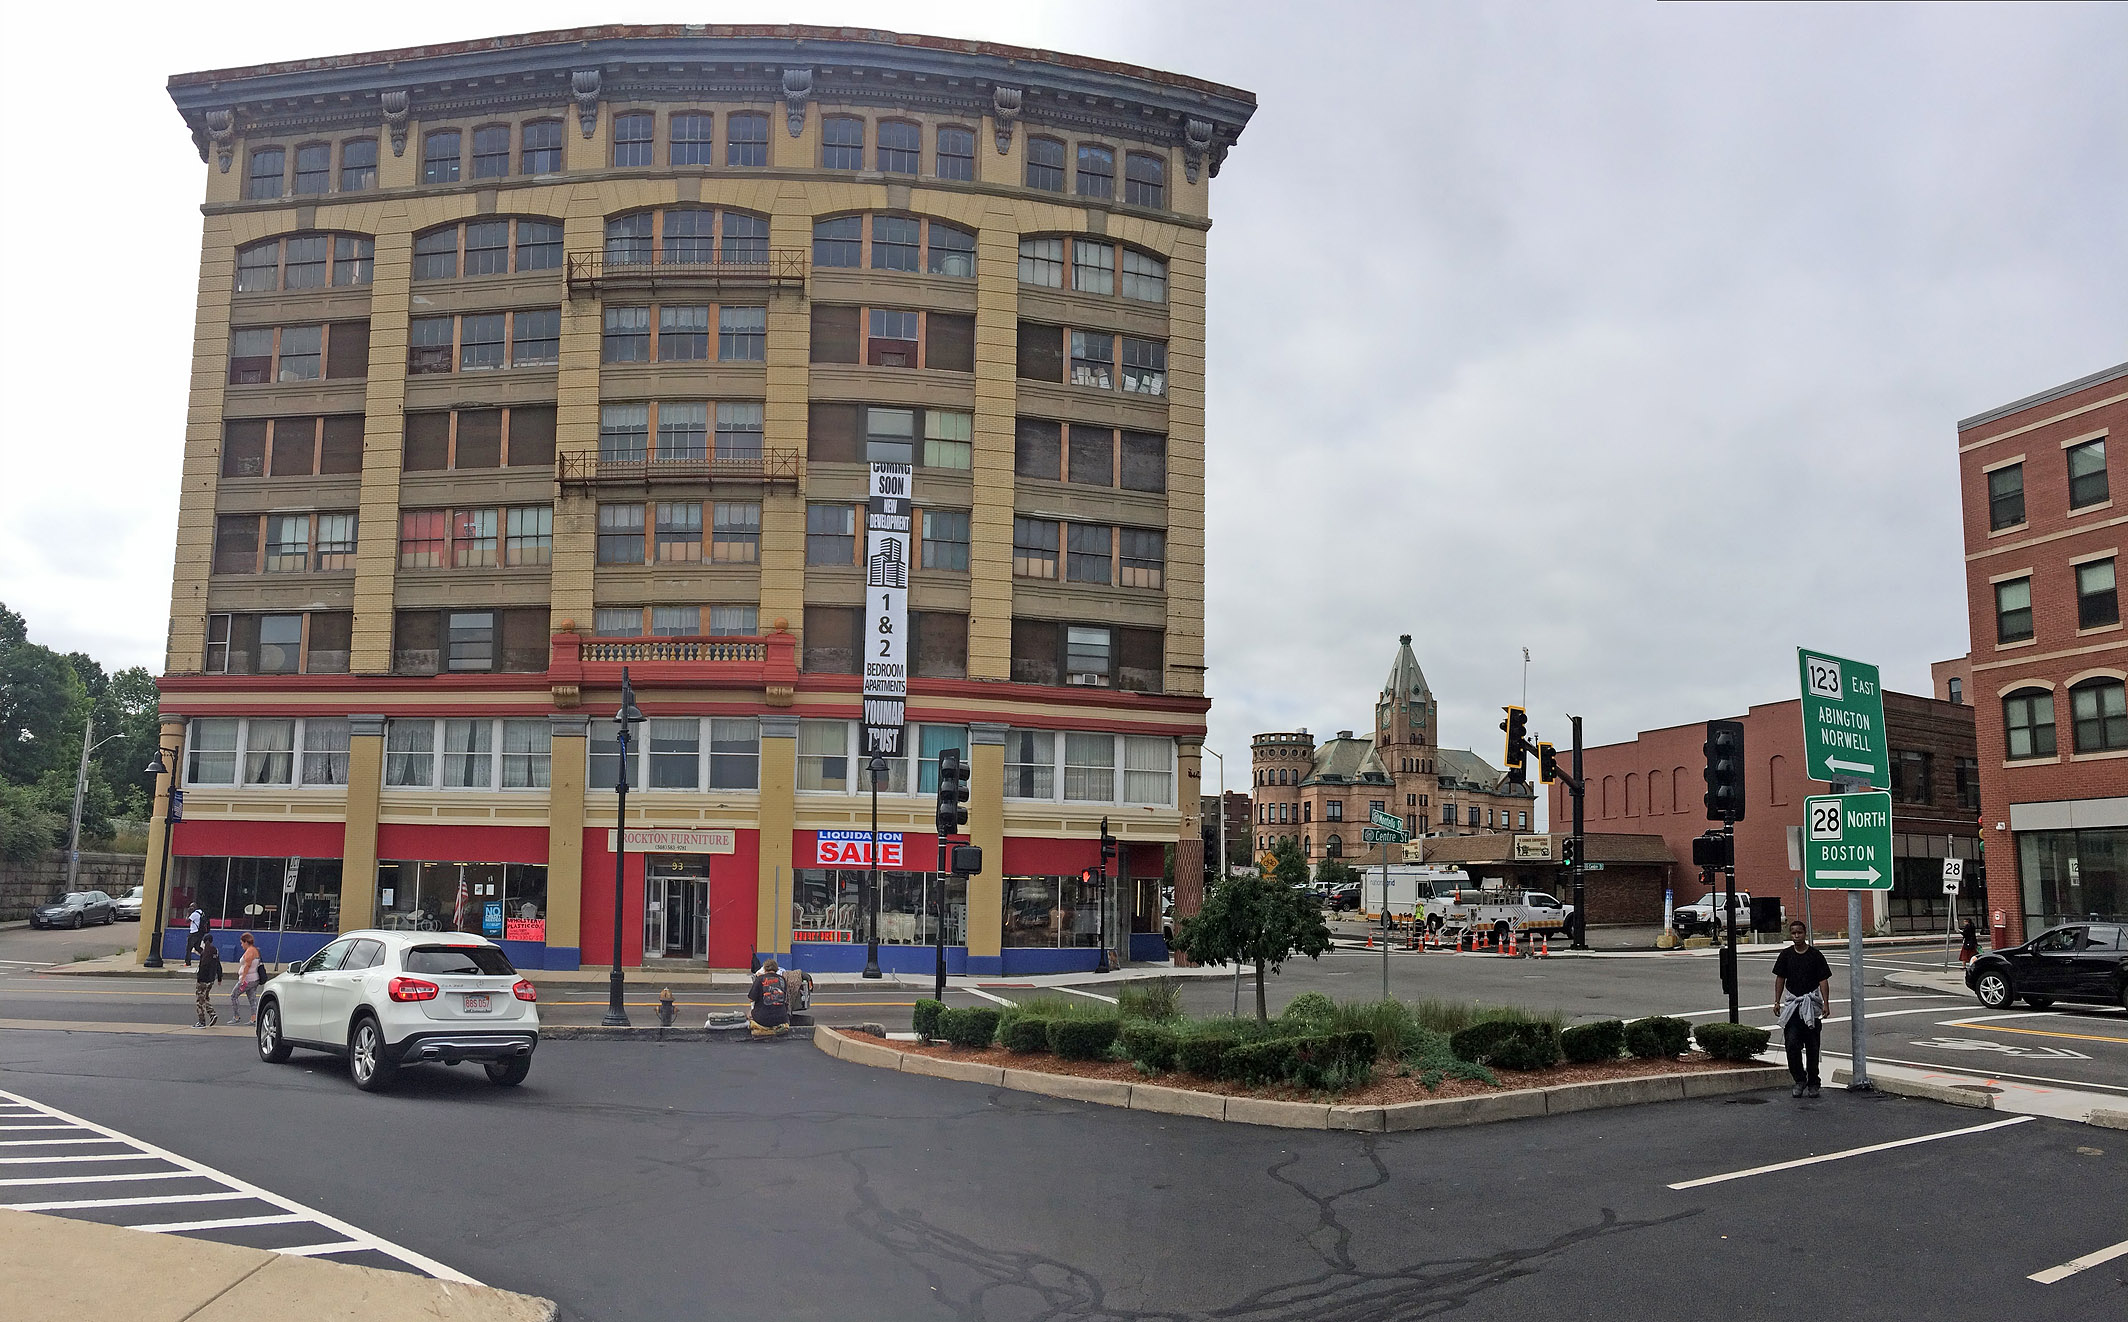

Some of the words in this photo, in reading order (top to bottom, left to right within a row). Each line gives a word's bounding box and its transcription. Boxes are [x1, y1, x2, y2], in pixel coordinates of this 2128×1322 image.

[879, 475, 904, 495] SOON
[883, 499, 898, 514] NEW
[870, 513, 910, 531] DEVELOPMENT
[882, 593, 890, 611] 1
[878, 616, 893, 635] &
[879, 640, 891, 657] 2
[867, 663, 904, 678] BEDROOM
[865, 678, 906, 693] APARTMENTS
[1809, 665, 1840, 693] 123
[1852, 676, 1875, 696] EAST
[864, 700, 905, 726] YOUMAR
[1818, 706, 1871, 731] ABINGTON
[1821, 728, 1872, 752] NORWELL
[1813, 807, 1840, 832] 28
[1847, 810, 1886, 828] NORTH
[617, 832, 669, 844] ROCKTON
[671, 833, 730, 846] FURNITURE
[1375, 830, 1397, 842] Centre
[1400, 832, 1408, 843] St
[819, 842, 901, 864] SALE
[1822, 845, 1875, 861] BOSTON
[671, 861, 684, 871] 93
[1945, 862, 1961, 876] 28
[288, 876, 296, 887] 27
[485, 907, 501, 916] NO
